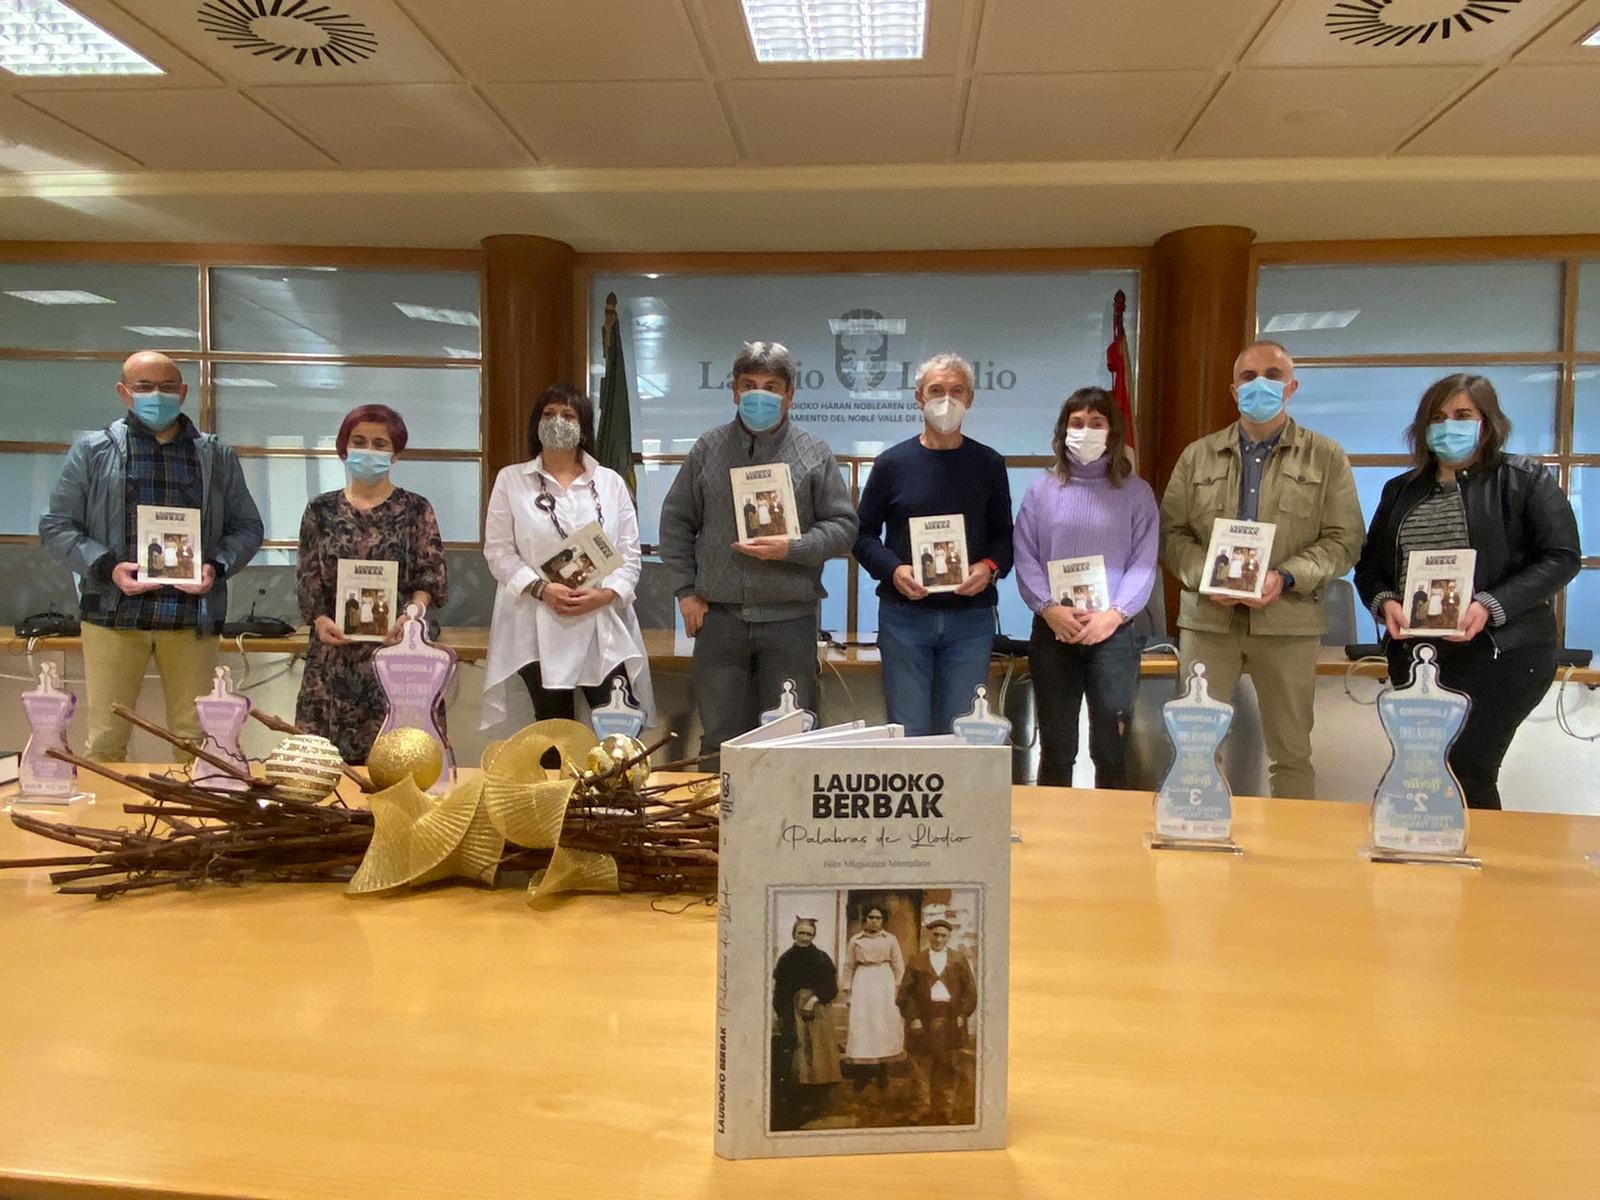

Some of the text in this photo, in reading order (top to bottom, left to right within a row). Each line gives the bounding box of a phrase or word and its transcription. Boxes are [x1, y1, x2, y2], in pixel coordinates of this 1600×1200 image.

[698, 361, 824, 390] Laio
[821, 402, 851, 411] HARAN
[854, 402, 905, 411] NOBLEAREN
[830, 414, 846, 423] DEL
[848, 414, 875, 423] NOBLE
[878, 414, 903, 423] VALLE
[905, 414, 918, 423] DE
[813, 773, 944, 792] LAUDIOKO
[812, 793, 944, 819] BERBAK
[782, 823, 973, 850] Palabras de Llodio
[719, 1027, 727, 1071] BERBAK
[718, 1073, 727, 1134] LAUDIOKO
